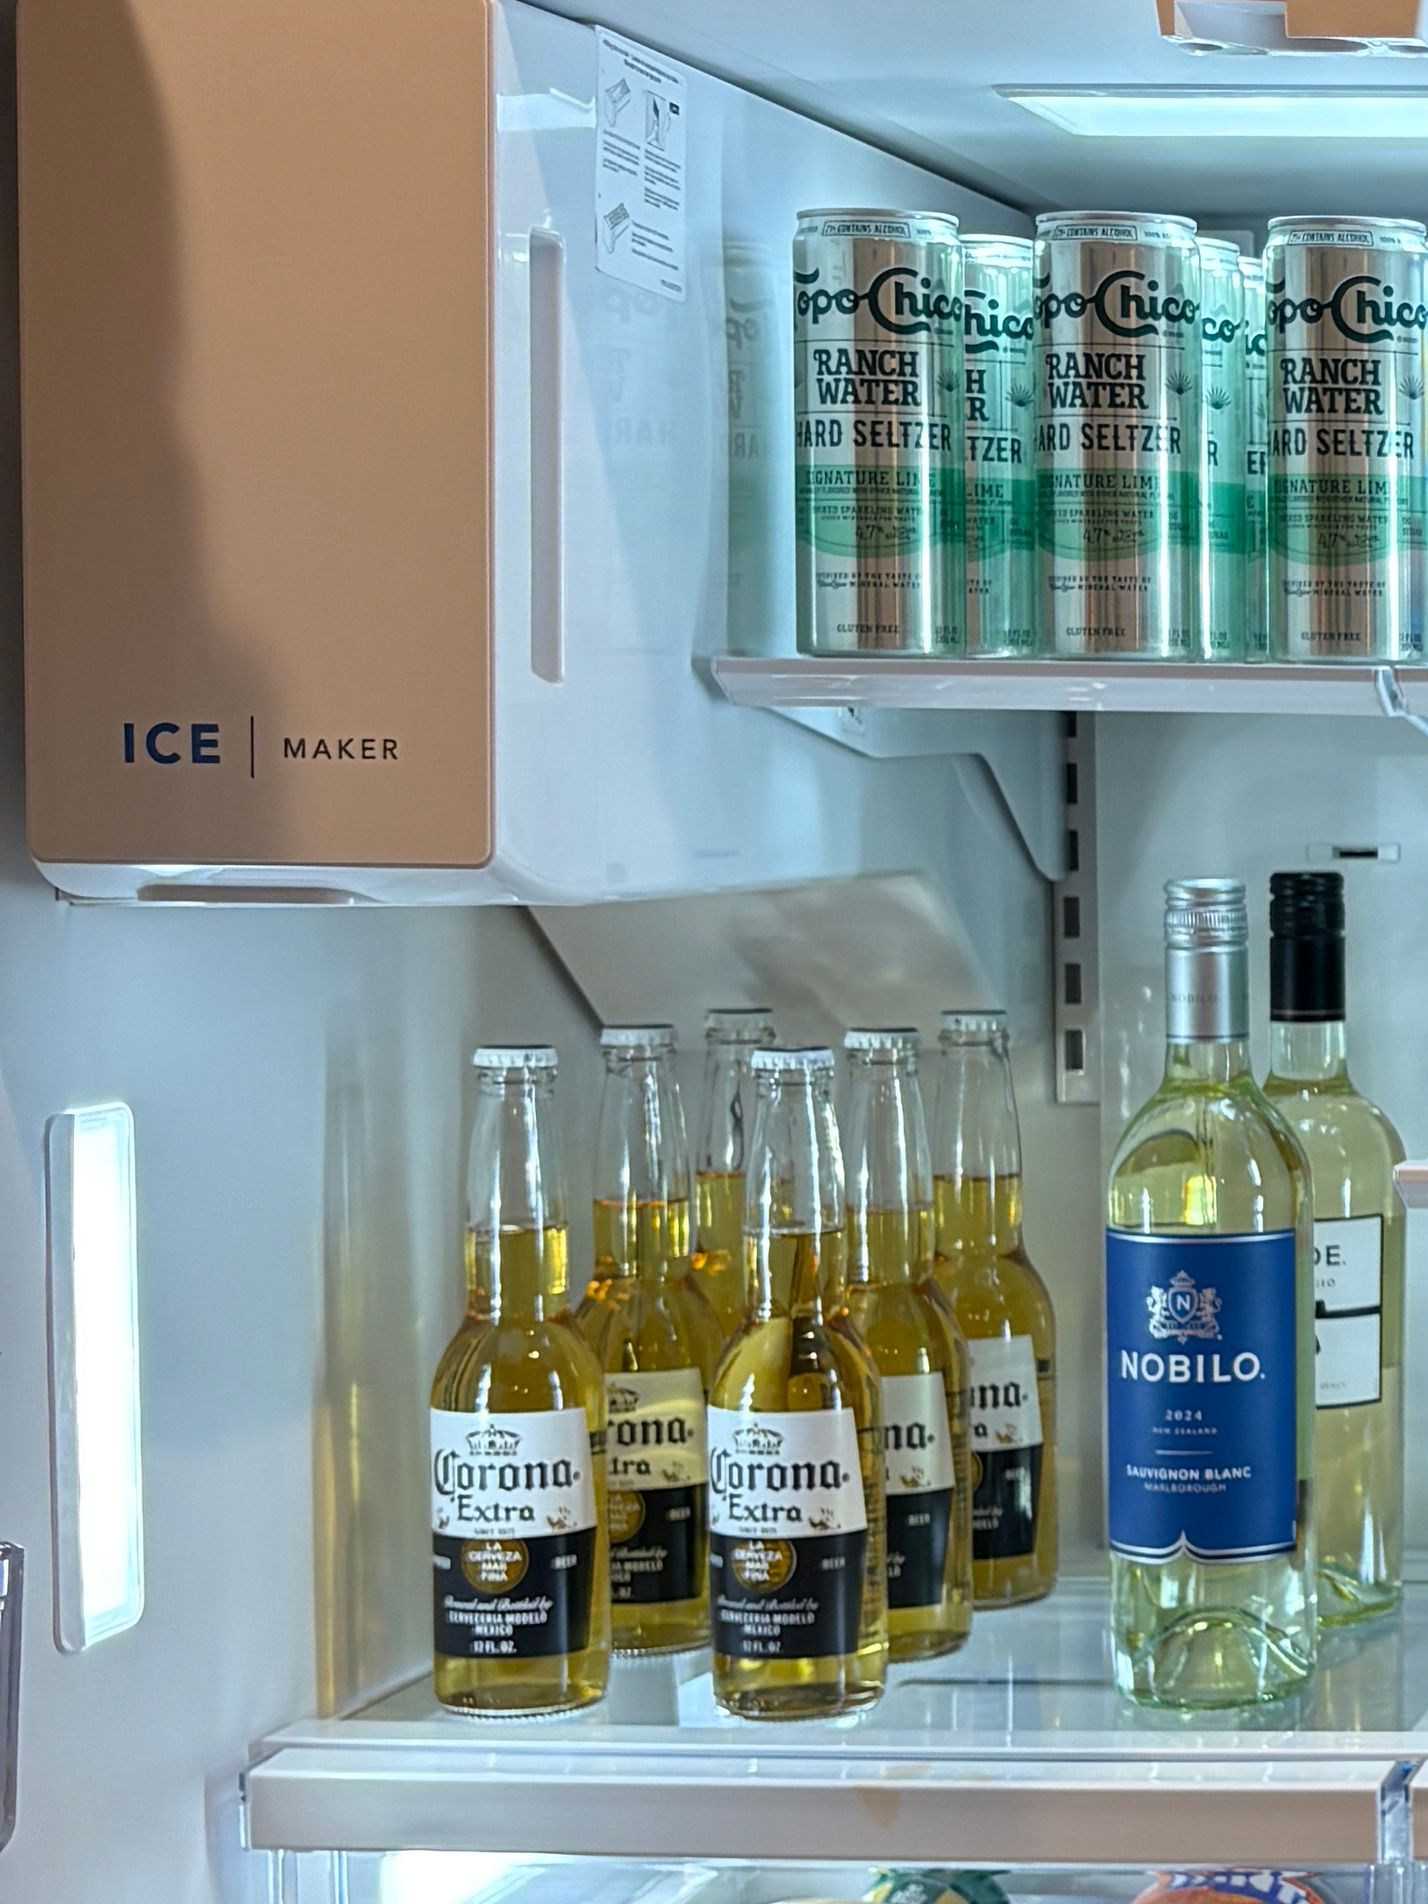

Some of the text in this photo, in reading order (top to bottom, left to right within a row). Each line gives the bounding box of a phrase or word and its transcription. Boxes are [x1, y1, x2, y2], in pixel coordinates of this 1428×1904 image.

[1093, 270, 1200, 339] Chico
[813, 348, 920, 378] RANCH
[1045, 352, 1147, 381] RANCH
[1280, 358, 1382, 386] RANCH
[816, 378, 922, 407] WATER
[1048, 381, 1149, 410] WATER
[1283, 387, 1385, 416] WATER
[798, 420, 952, 452] ARD SELTZER
[1036, 423, 1182, 454] ARD SELTZER
[1268, 429, 1414, 459] ARD SELTZER
[123, 721, 400, 765] ICE MAKER
[1176, 1295, 1190, 1311] N
[1164, 1409, 1203, 1422] 2024
[434, 1448, 574, 1497] Corona
[711, 1446, 842, 1497] Corona
[1126, 1464, 1252, 1481] SAUVIGNON BLANC
[1143, 1482, 1227, 1494] MARLBOROUGH
[456, 1494, 535, 1524] Extra
[728, 1494, 804, 1524] Extra
